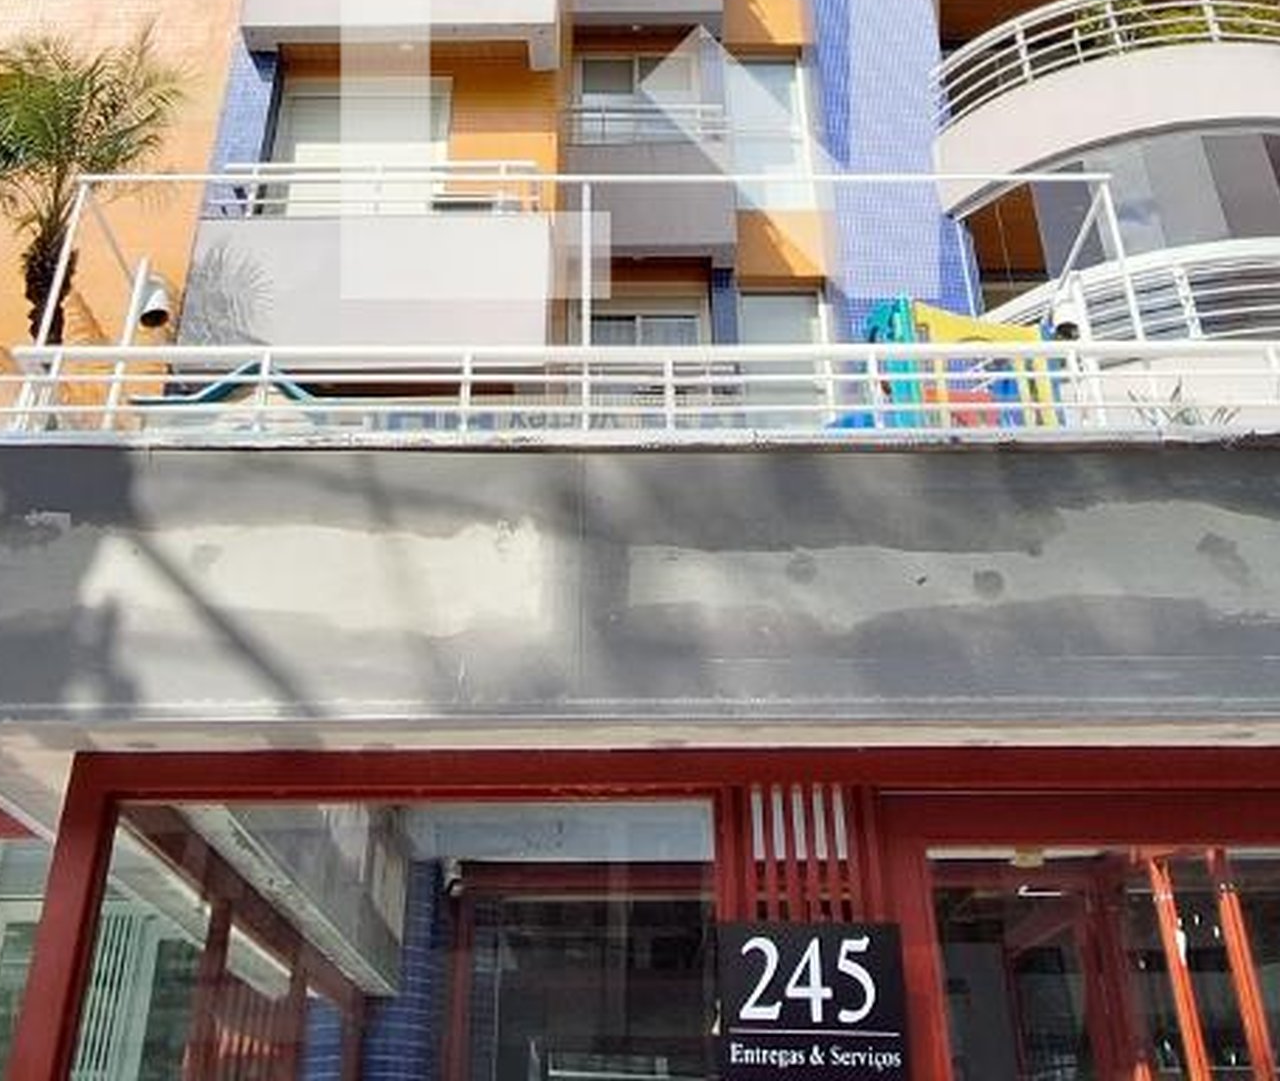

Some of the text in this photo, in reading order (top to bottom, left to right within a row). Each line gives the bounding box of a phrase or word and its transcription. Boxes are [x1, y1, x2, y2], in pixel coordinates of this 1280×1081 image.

[739, 936, 877, 1023] 245
[730, 1042, 902, 1071] Entregas & Serviços
